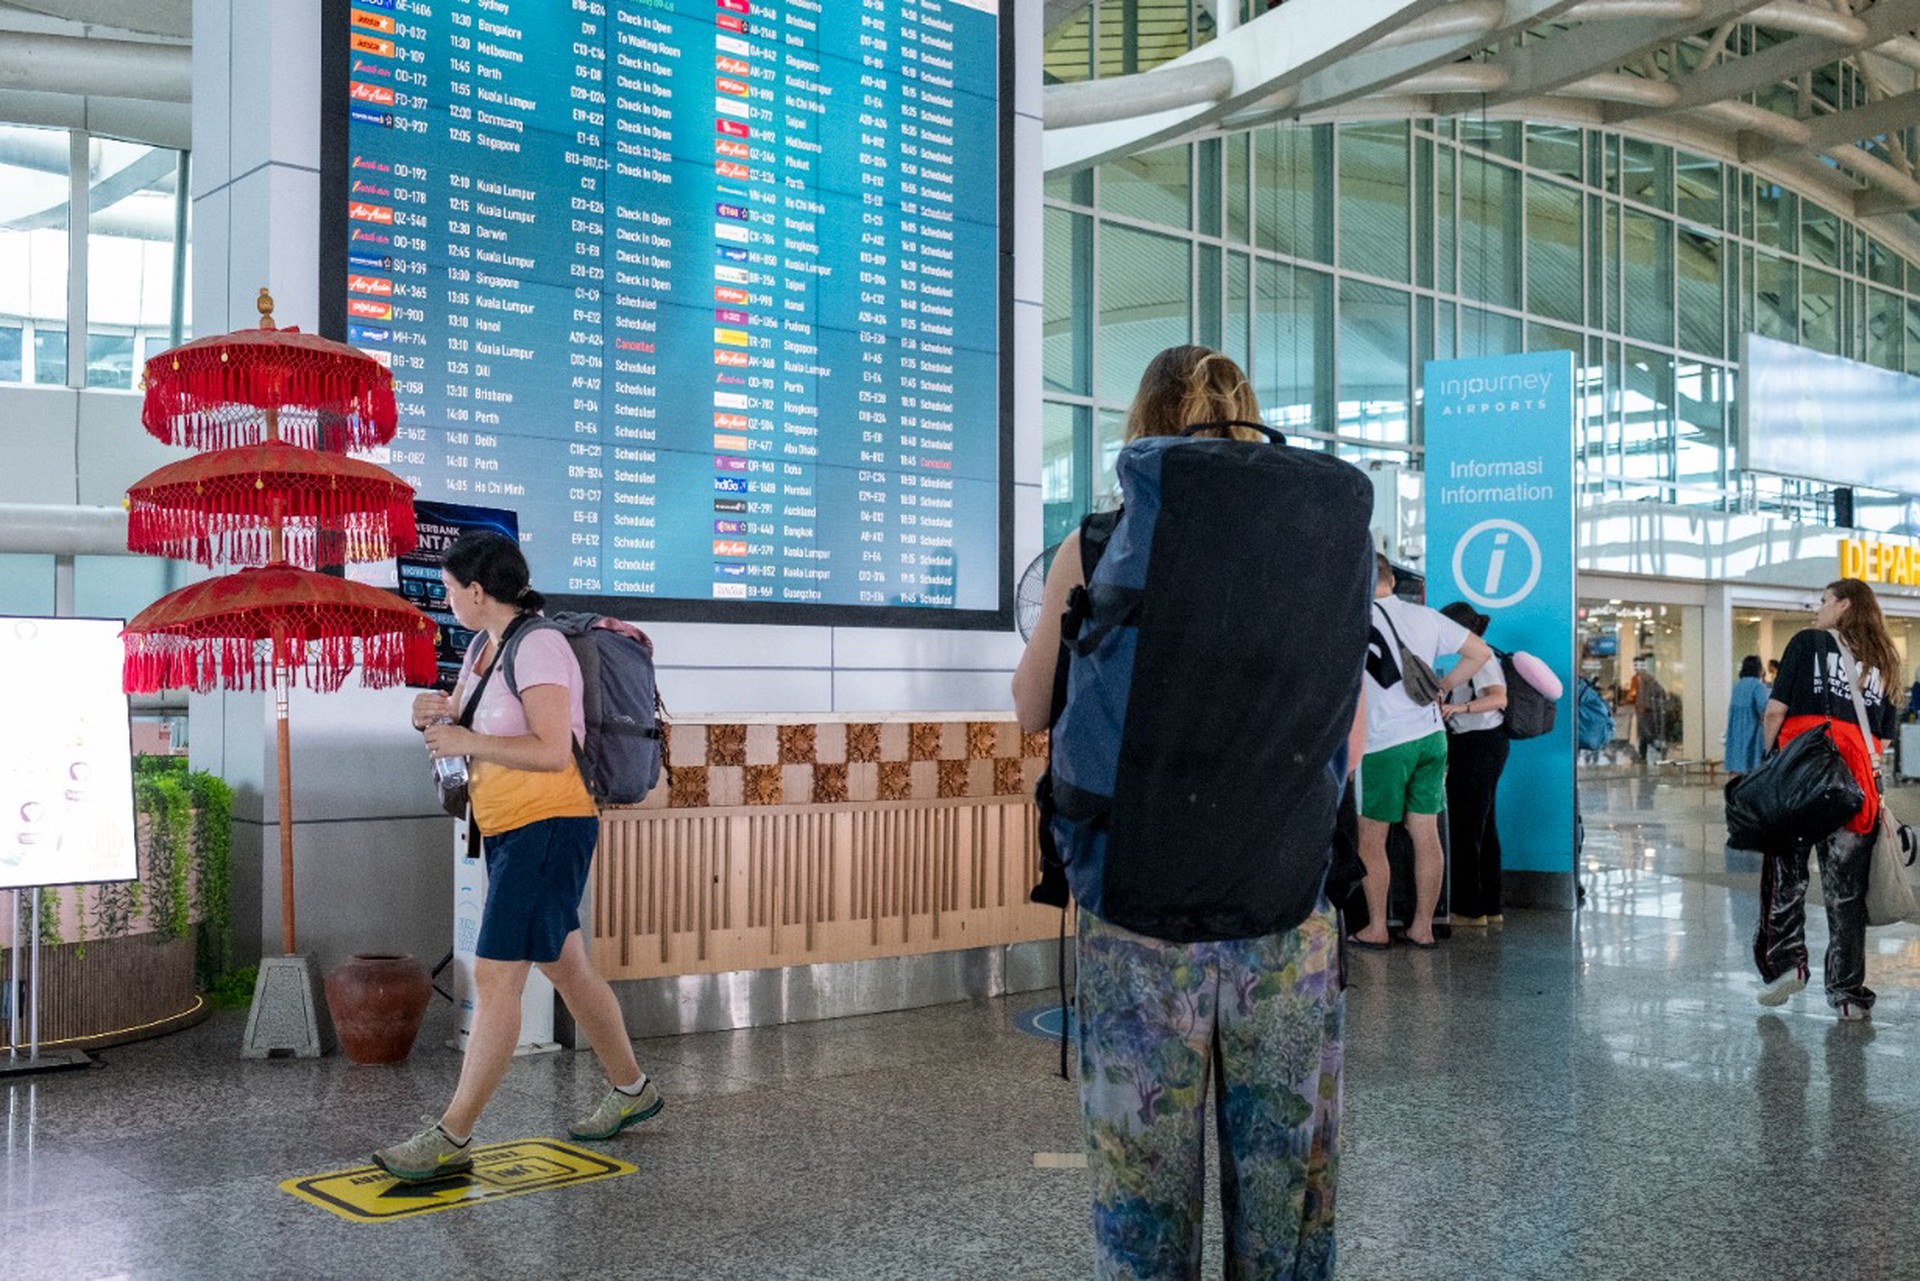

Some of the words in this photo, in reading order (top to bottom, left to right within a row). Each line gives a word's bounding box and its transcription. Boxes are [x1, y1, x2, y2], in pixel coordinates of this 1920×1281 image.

[477, 64, 502, 81] Perth
[477, 133, 521, 153] Singapore
[394, 163, 427, 181] OD-192
[476, 179, 503, 195] Kuala
[503, 184, 536, 201] Lumpur
[449, 197, 469, 212] 12:15
[476, 202, 503, 218] Kuala
[503, 207, 536, 223] Lumpur
[476, 225, 508, 241] Darwin
[476, 248, 503, 263] Kuala
[503, 253, 535, 269] Lumpur
[1442, 399, 1547, 415] AIRPORTS
[1450, 456, 1543, 479] Informasi
[1441, 482, 1554, 505] Information
